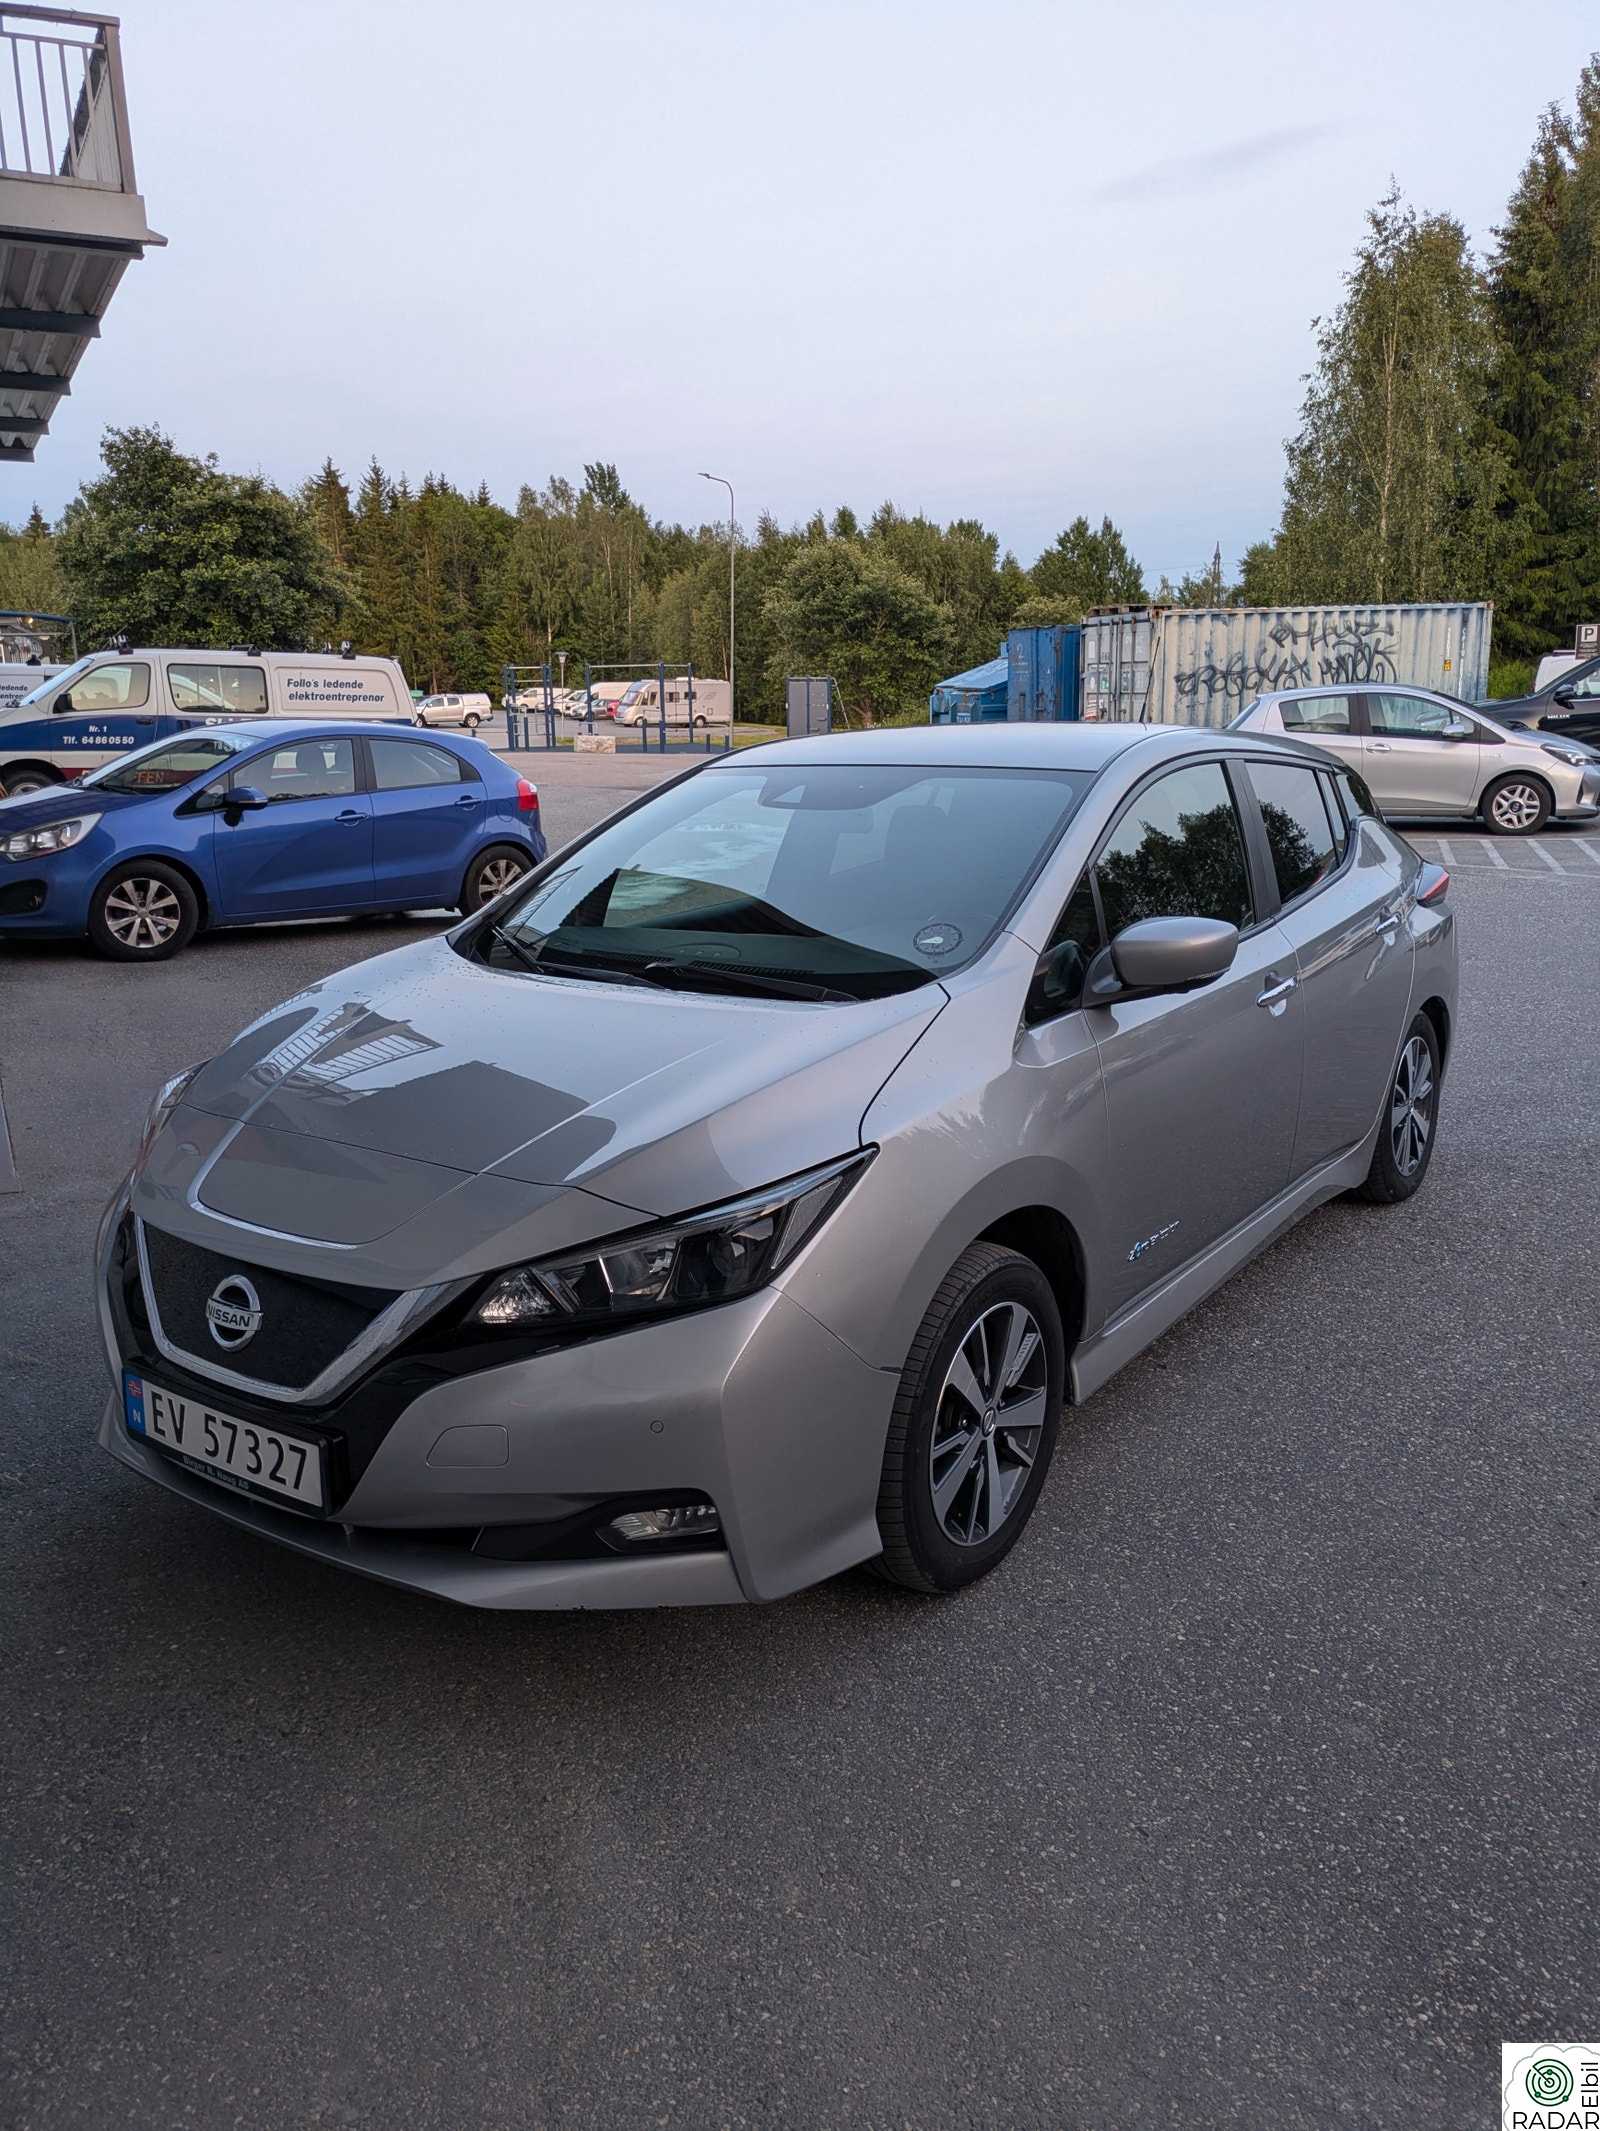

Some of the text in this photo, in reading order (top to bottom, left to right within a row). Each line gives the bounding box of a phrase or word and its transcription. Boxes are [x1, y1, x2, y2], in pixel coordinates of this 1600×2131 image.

[1584, 627, 1594, 640] P
[323, 679, 364, 689] ledende
[288, 691, 385, 703] elektroentreprenør
[88, 725, 107, 733] Nr. 1
[62, 736, 135, 745] Tlf. 64 86 05 50
[208, 1303, 251, 1327] NISSAN
[133, 1409, 142, 1424] N
[151, 1390, 307, 1491] EV 57327
[183, 1455, 205, 1472] Birger
[217, 1470, 237, 1487] Haug
[238, 1478, 249, 1490] AS
